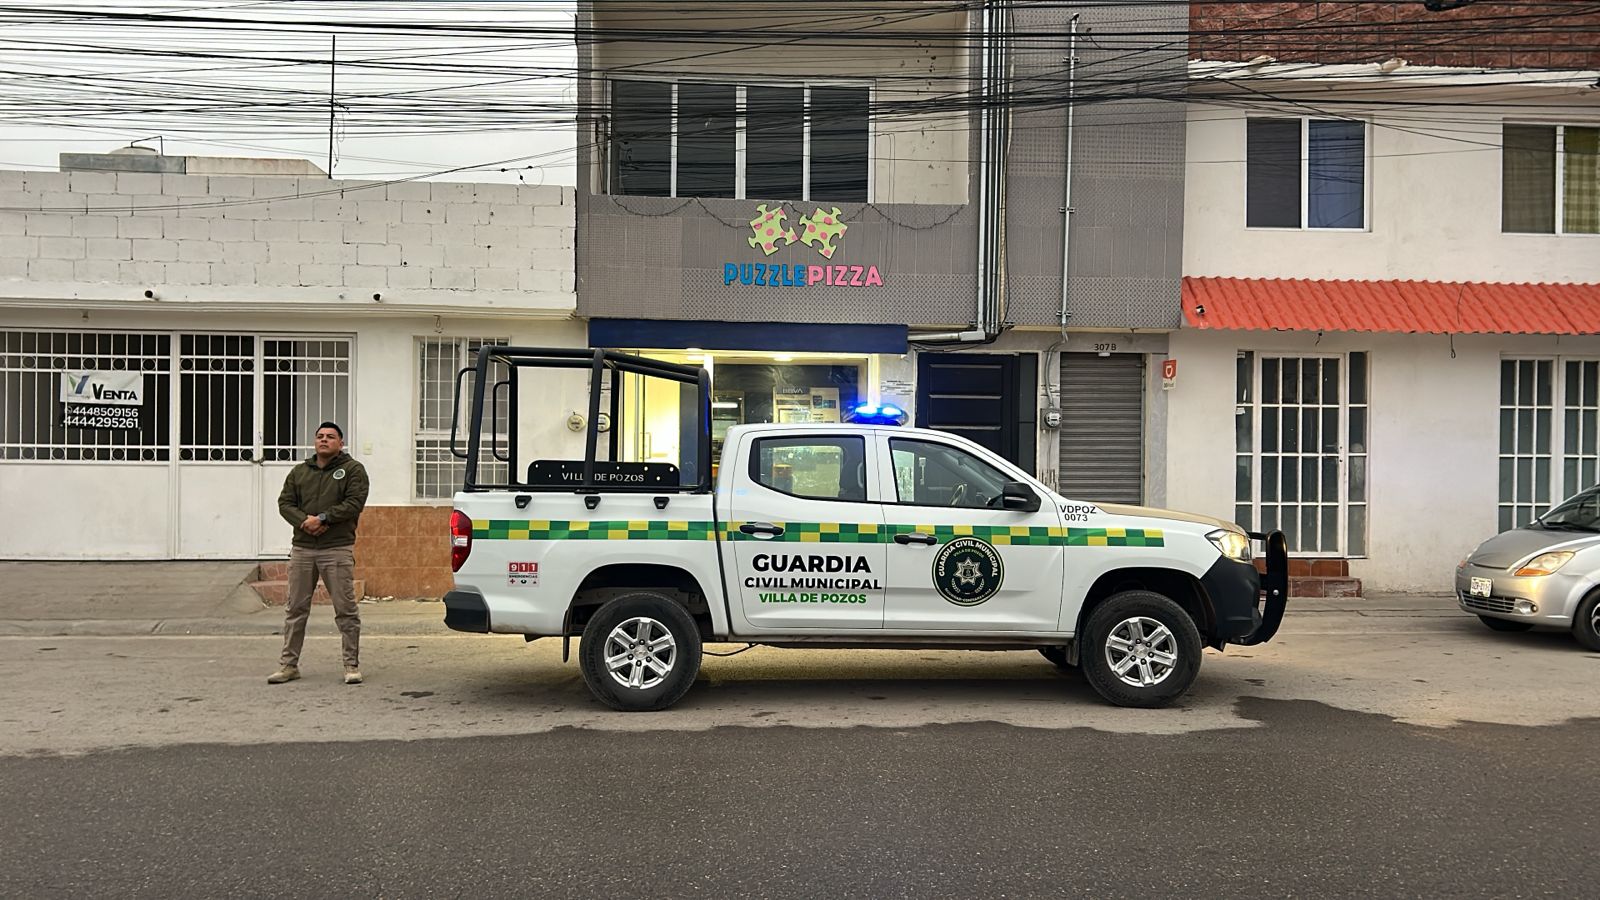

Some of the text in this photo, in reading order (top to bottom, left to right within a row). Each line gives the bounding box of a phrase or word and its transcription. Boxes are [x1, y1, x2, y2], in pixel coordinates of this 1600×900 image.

[73, 406, 139, 417] 4448509156
[64, 416, 139, 428] 4444295261
[562, 472, 644, 482] VILL DE POZOS
[1060, 505, 1097, 514] VDPOZ
[1064, 513, 1088, 521] 0073
[752, 554, 871, 573] GUARDIA
[938, 540, 999, 577] GUARDIA CIVIL MUNICIPAL
[510, 563, 536, 571] 911
[744, 577, 882, 590] CIVIL MUNICIPAL
[759, 593, 867, 604] VILLA DE POZOS
